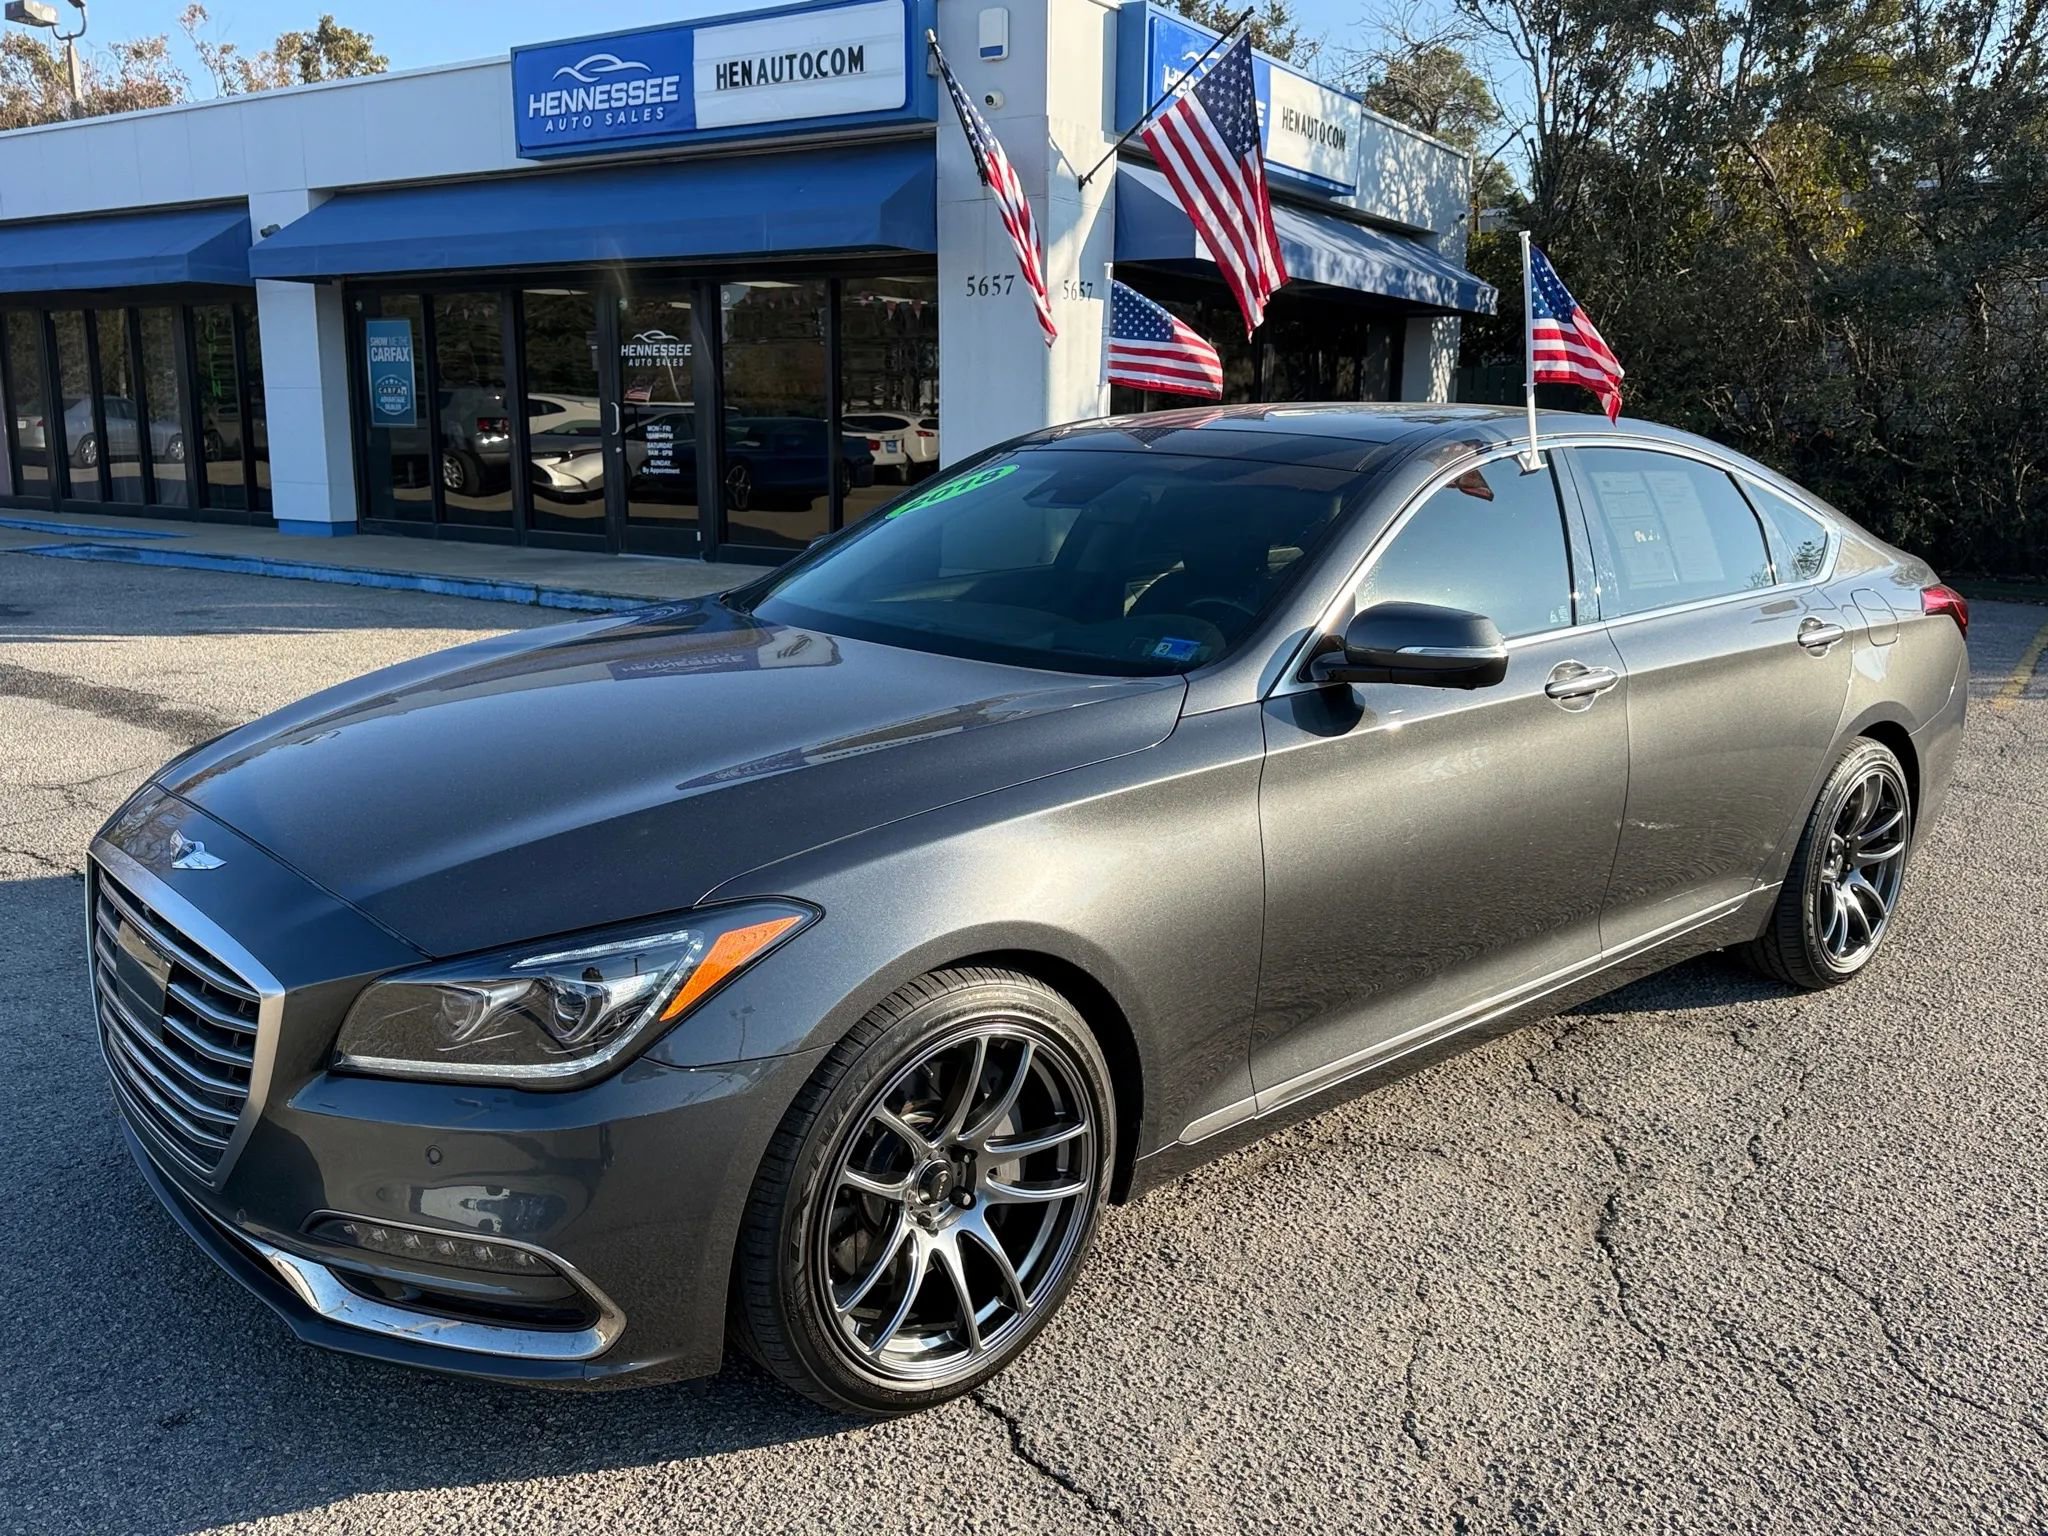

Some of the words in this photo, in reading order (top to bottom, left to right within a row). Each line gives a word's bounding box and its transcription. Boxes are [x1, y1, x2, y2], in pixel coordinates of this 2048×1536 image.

[716, 45, 864, 90] HENAUTO.COM
[528, 75, 680, 118] HENNESSEE
[545, 115, 593, 132] AUTO
[605, 106, 665, 126] SALES
[966, 274, 1015, 296] 5657
[1063, 279, 1093, 301] 5657
[371, 347, 410, 362] CARFAX
[620, 344, 692, 356] HENNESSEE
[628, 358, 653, 367] AUTO
[656, 358, 684, 367] SALES
